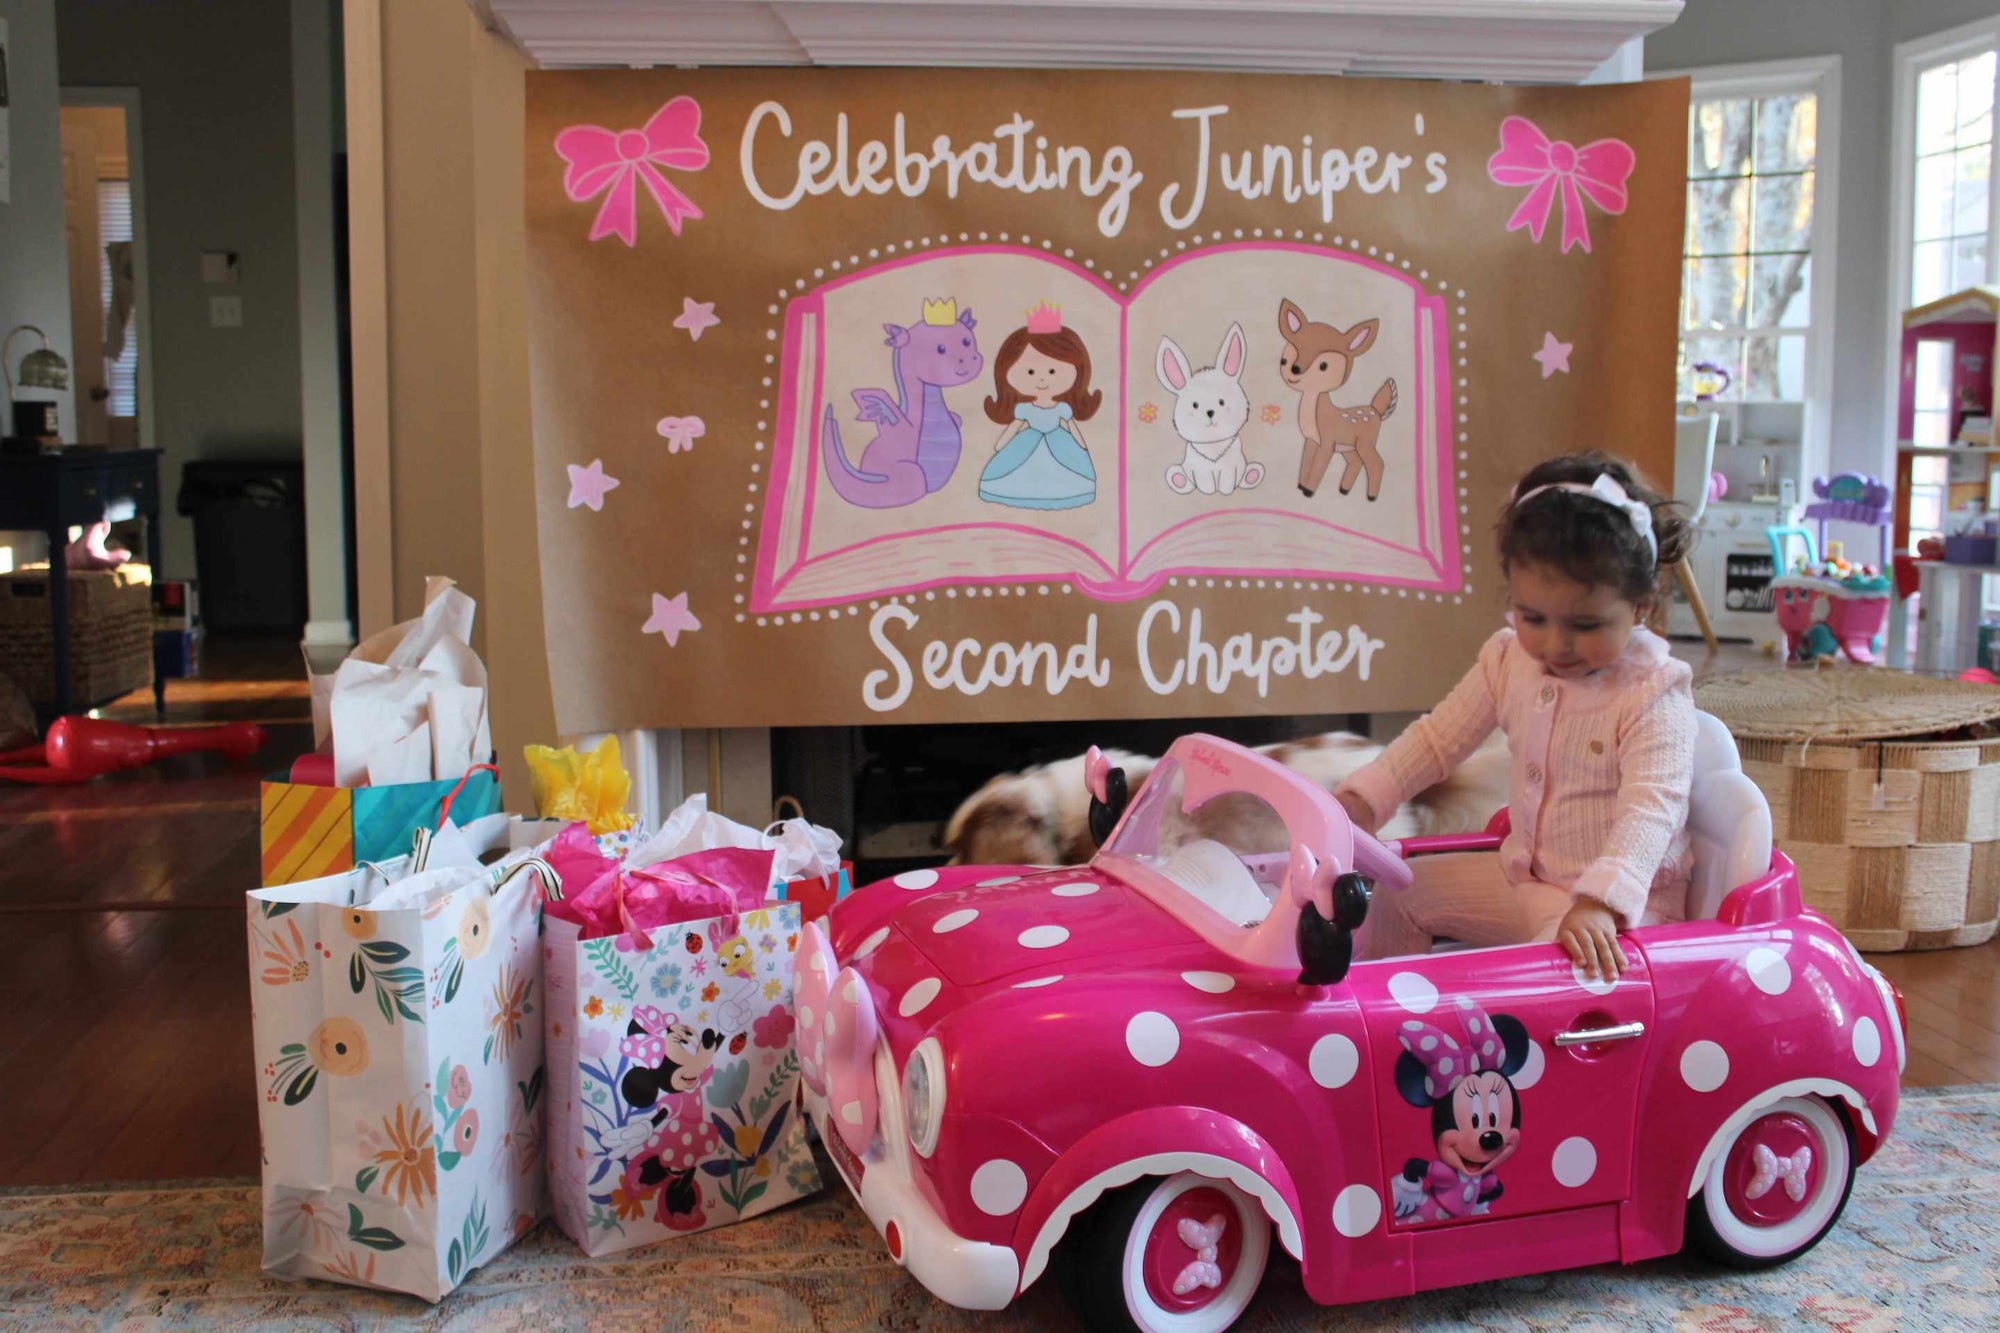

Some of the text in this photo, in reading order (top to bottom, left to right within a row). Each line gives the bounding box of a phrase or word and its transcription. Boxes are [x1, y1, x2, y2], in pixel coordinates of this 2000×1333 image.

[740, 101, 1448, 237] Celebrating Juniper's
[862, 600, 1385, 712] Second Chapter
